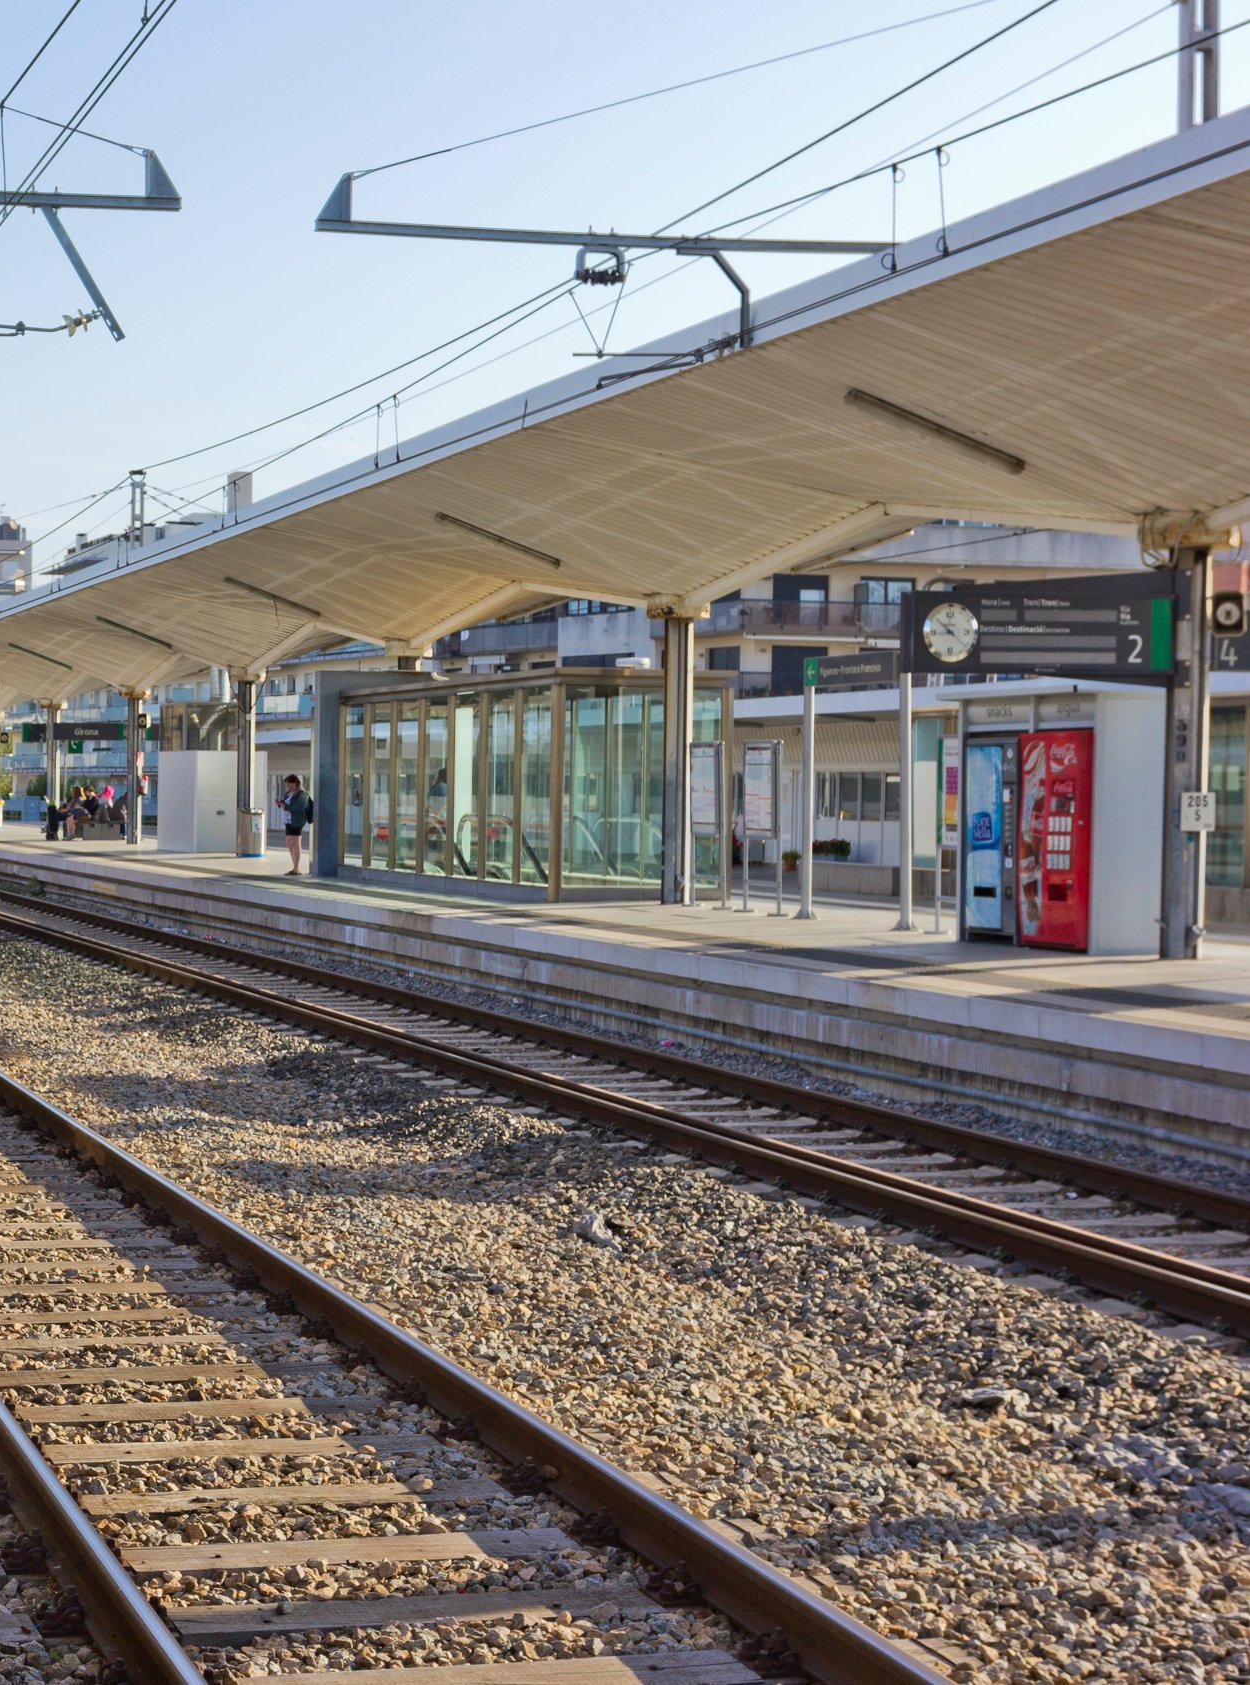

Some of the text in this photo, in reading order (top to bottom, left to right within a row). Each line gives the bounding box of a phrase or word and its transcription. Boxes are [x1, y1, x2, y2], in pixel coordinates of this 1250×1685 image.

[981, 598, 998, 607] Hora
[1023, 598, 1038, 606] Tren
[1040, 598, 1057, 607] Tren
[945, 611, 955, 619] 12
[980, 625, 1005, 633] Destino
[1008, 624, 1044, 633] Destinació
[1127, 634, 1143, 663] 2
[1220, 639, 1238, 667] 4
[986, 705, 1013, 718] snacks
[1056, 703, 1081, 717] aigua
[74, 728, 99, 736] Girona
[1187, 795, 1209, 808] 205
